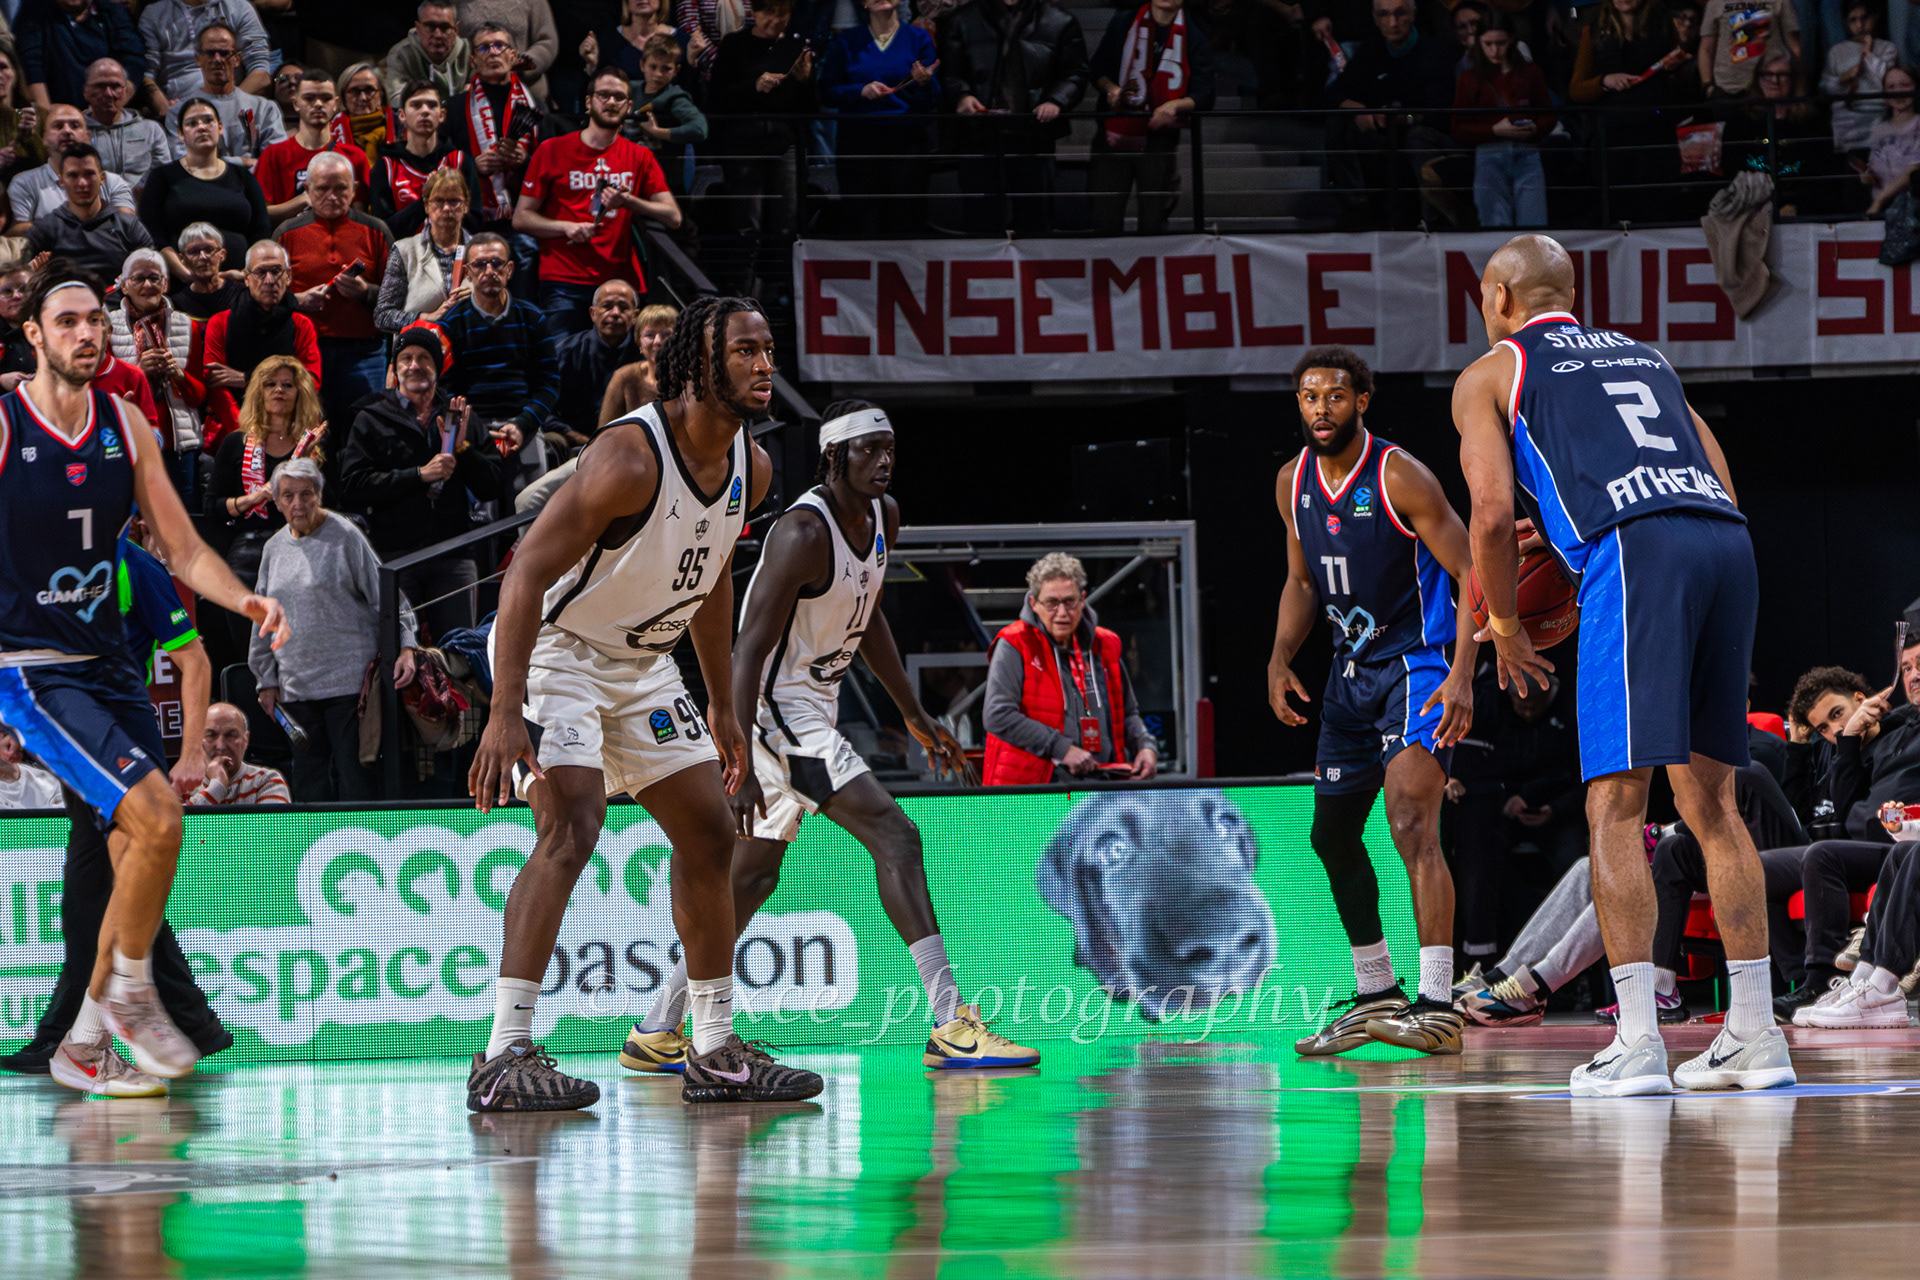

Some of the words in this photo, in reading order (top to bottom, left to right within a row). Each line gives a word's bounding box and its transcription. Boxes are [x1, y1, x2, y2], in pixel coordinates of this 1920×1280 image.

[803, 253, 1375, 355] ENSEMBLE
[1446, 248, 1735, 344] NUS
[1544, 332, 1635, 349] STARKS
[1591, 358, 1661, 369] CHERY
[1602, 381, 1677, 451] 2
[1606, 466, 1732, 512] ATHENS
[67, 508, 92, 550] 7
[672, 547, 710, 591] 95
[1320, 556, 1350, 595] 11
[846, 592, 868, 631] 11
